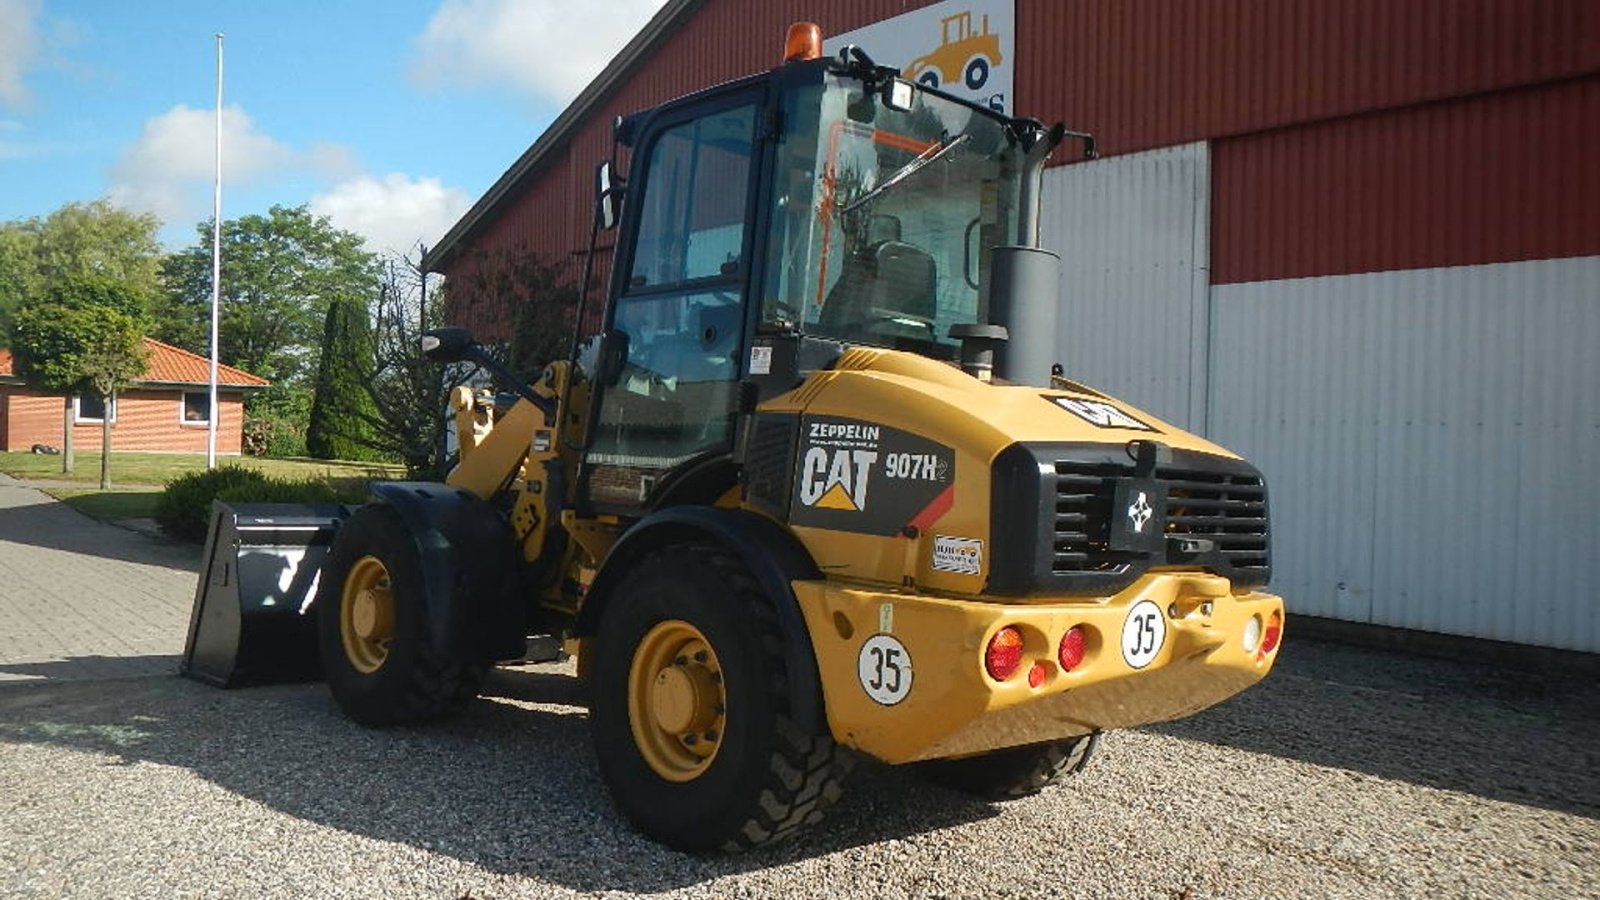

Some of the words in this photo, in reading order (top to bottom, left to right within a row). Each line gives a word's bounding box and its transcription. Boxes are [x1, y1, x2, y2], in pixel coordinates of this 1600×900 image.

[809, 423, 880, 440] ZEPPELIN
[800, 447, 878, 512] CAT
[1131, 614, 1156, 656] 35
[869, 646, 901, 693] 35
